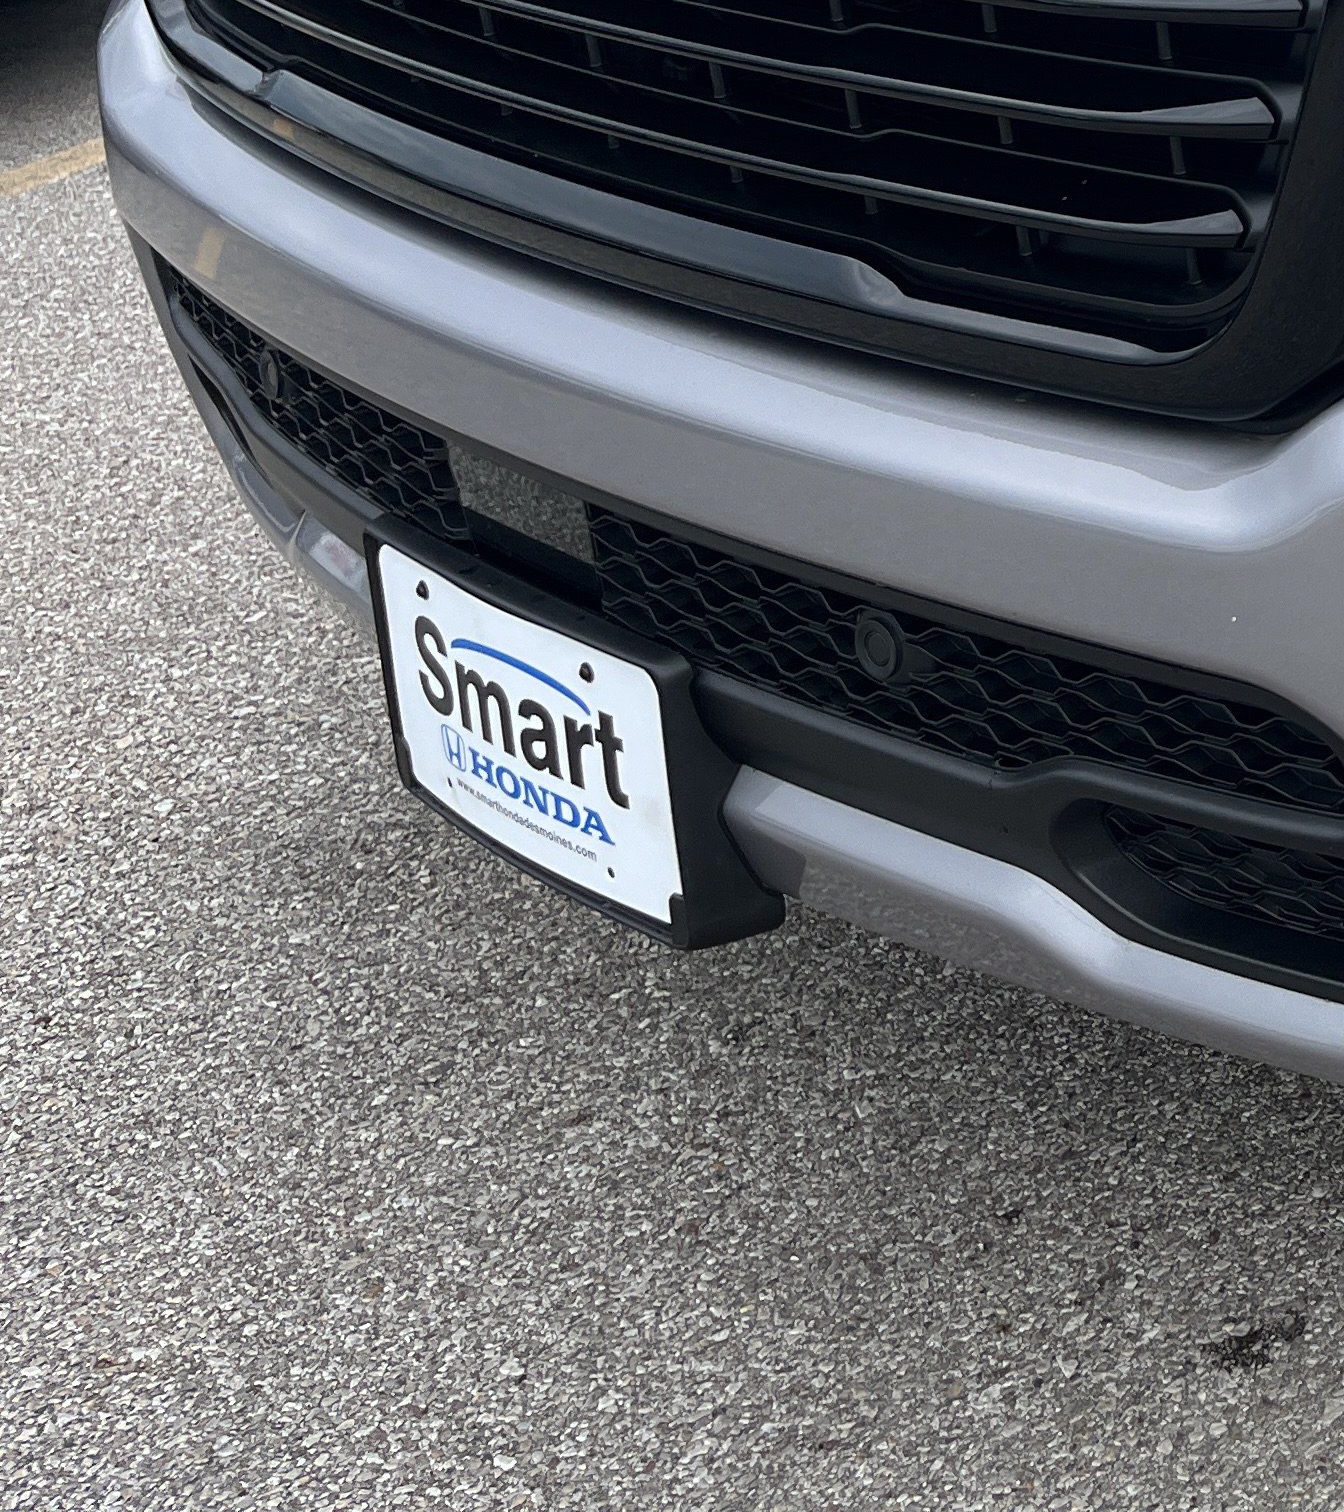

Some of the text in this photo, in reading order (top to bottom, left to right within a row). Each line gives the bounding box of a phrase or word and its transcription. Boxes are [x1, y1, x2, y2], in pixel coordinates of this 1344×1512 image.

[414, 614, 630, 810] Smart
[456, 777, 598, 863] www.smarthondadesmoines.com
[468, 745, 616, 847] HONDA
